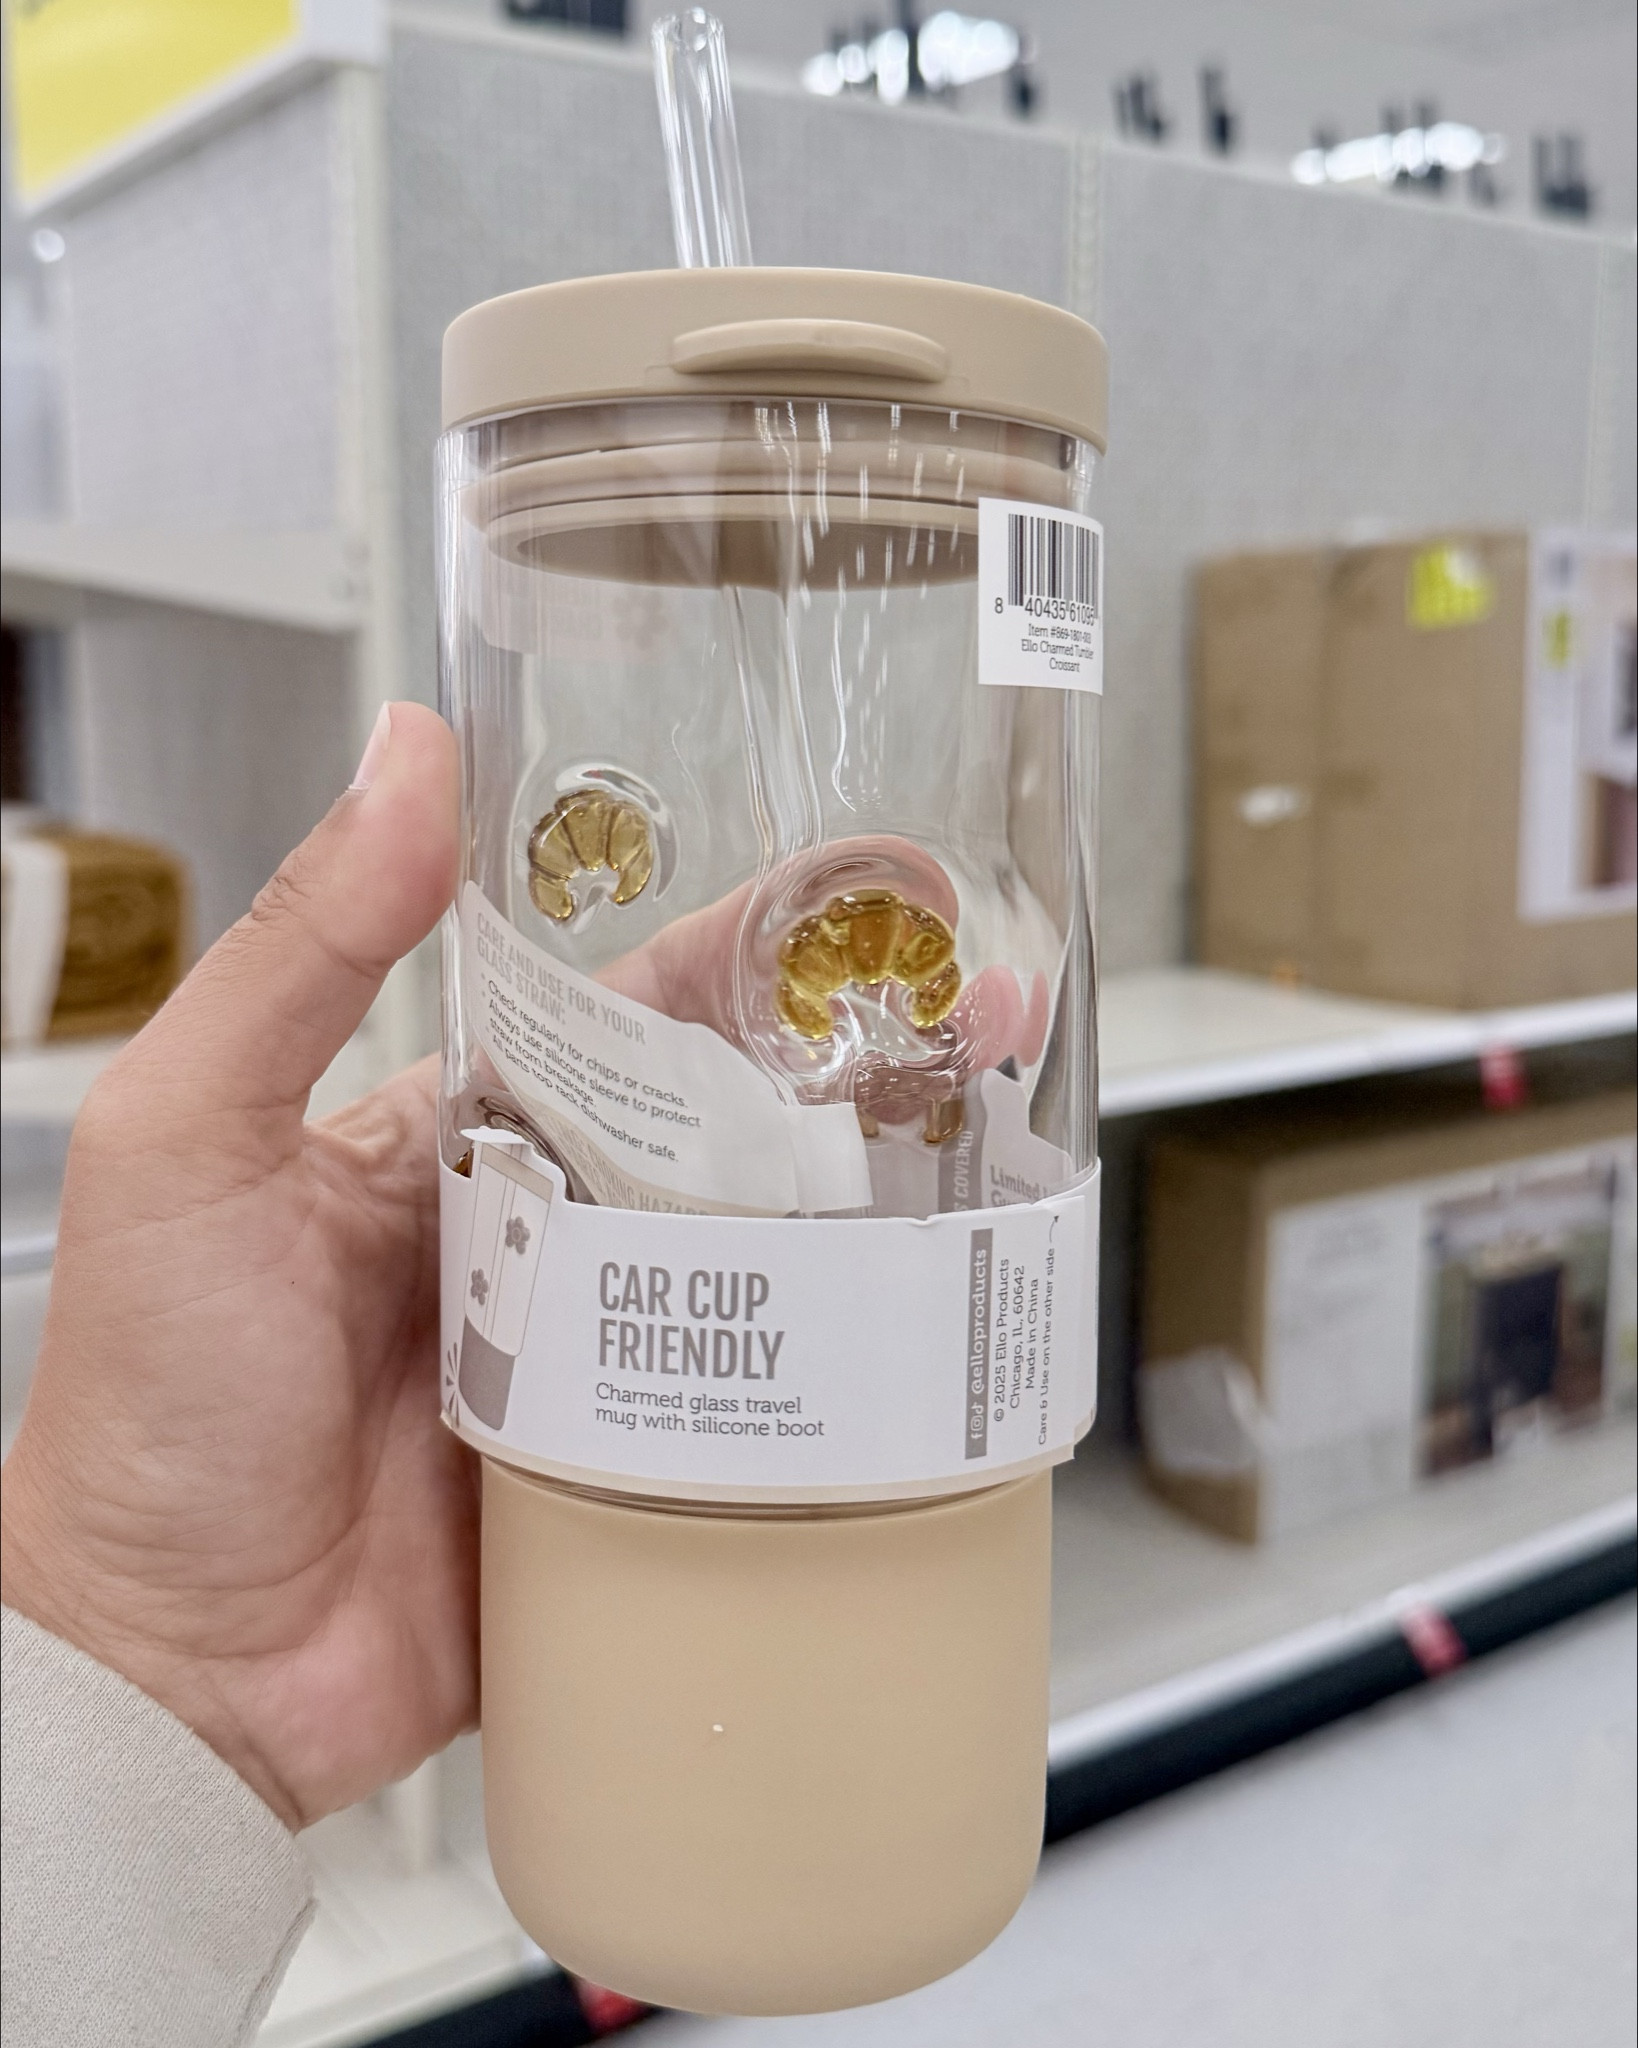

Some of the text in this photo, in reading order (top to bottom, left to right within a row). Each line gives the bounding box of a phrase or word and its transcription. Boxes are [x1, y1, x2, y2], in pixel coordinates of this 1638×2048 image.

[994, 597, 1004, 614] 8
[1025, 597, 1066, 620] 40435
[1021, 639, 1038, 652] Ello
[1040, 641, 1074, 656] Charmed
[1028, 623, 1049, 638] Item
[1049, 657, 1080, 672] Croissant
[477, 912, 647, 1044] CARE AND USE FOR YOUR
[477, 935, 566, 1025] GLASS STRAW:
[488, 980, 688, 1108] Check regularly for chips or cracks.
[490, 1018, 596, 1107] straw from breakage.
[489, 999, 702, 1127] Always use silicone sleeve to protect
[493, 1034, 504, 1052] All
[505, 1048, 530, 1073] parts
[531, 1067, 553, 1088] top
[556, 1084, 579, 1108] rack
[580, 1103, 644, 1149] dishwasher
[648, 1142, 679, 1162] safe.
[954, 1131, 974, 1198] COVERED
[990, 1164, 1040, 1200] Limited
[1046, 1248, 1055, 1276] side
[600, 1261, 770, 1322] CAR CUP
[996, 1258, 1009, 1328] Products
[1044, 1280, 1053, 1317] other
[971, 1249, 987, 1395] @elloproducts
[1010, 1265, 1025, 1409] Chicago, IL, 60642
[1026, 1278, 1039, 1389] Made in China
[1043, 1320, 1052, 1343] the
[599, 1317, 786, 1380] FRIENDLY
[995, 1331, 1007, 1360] Ello
[1043, 1346, 1050, 1366] on
[596, 1382, 802, 1415] Charmed glass travel
[994, 1365, 1006, 1403] 2025
[1040, 1370, 1049, 1396] Use
[596, 1407, 825, 1437] mug with silicone boot
[1038, 1412, 1047, 1445] Care
